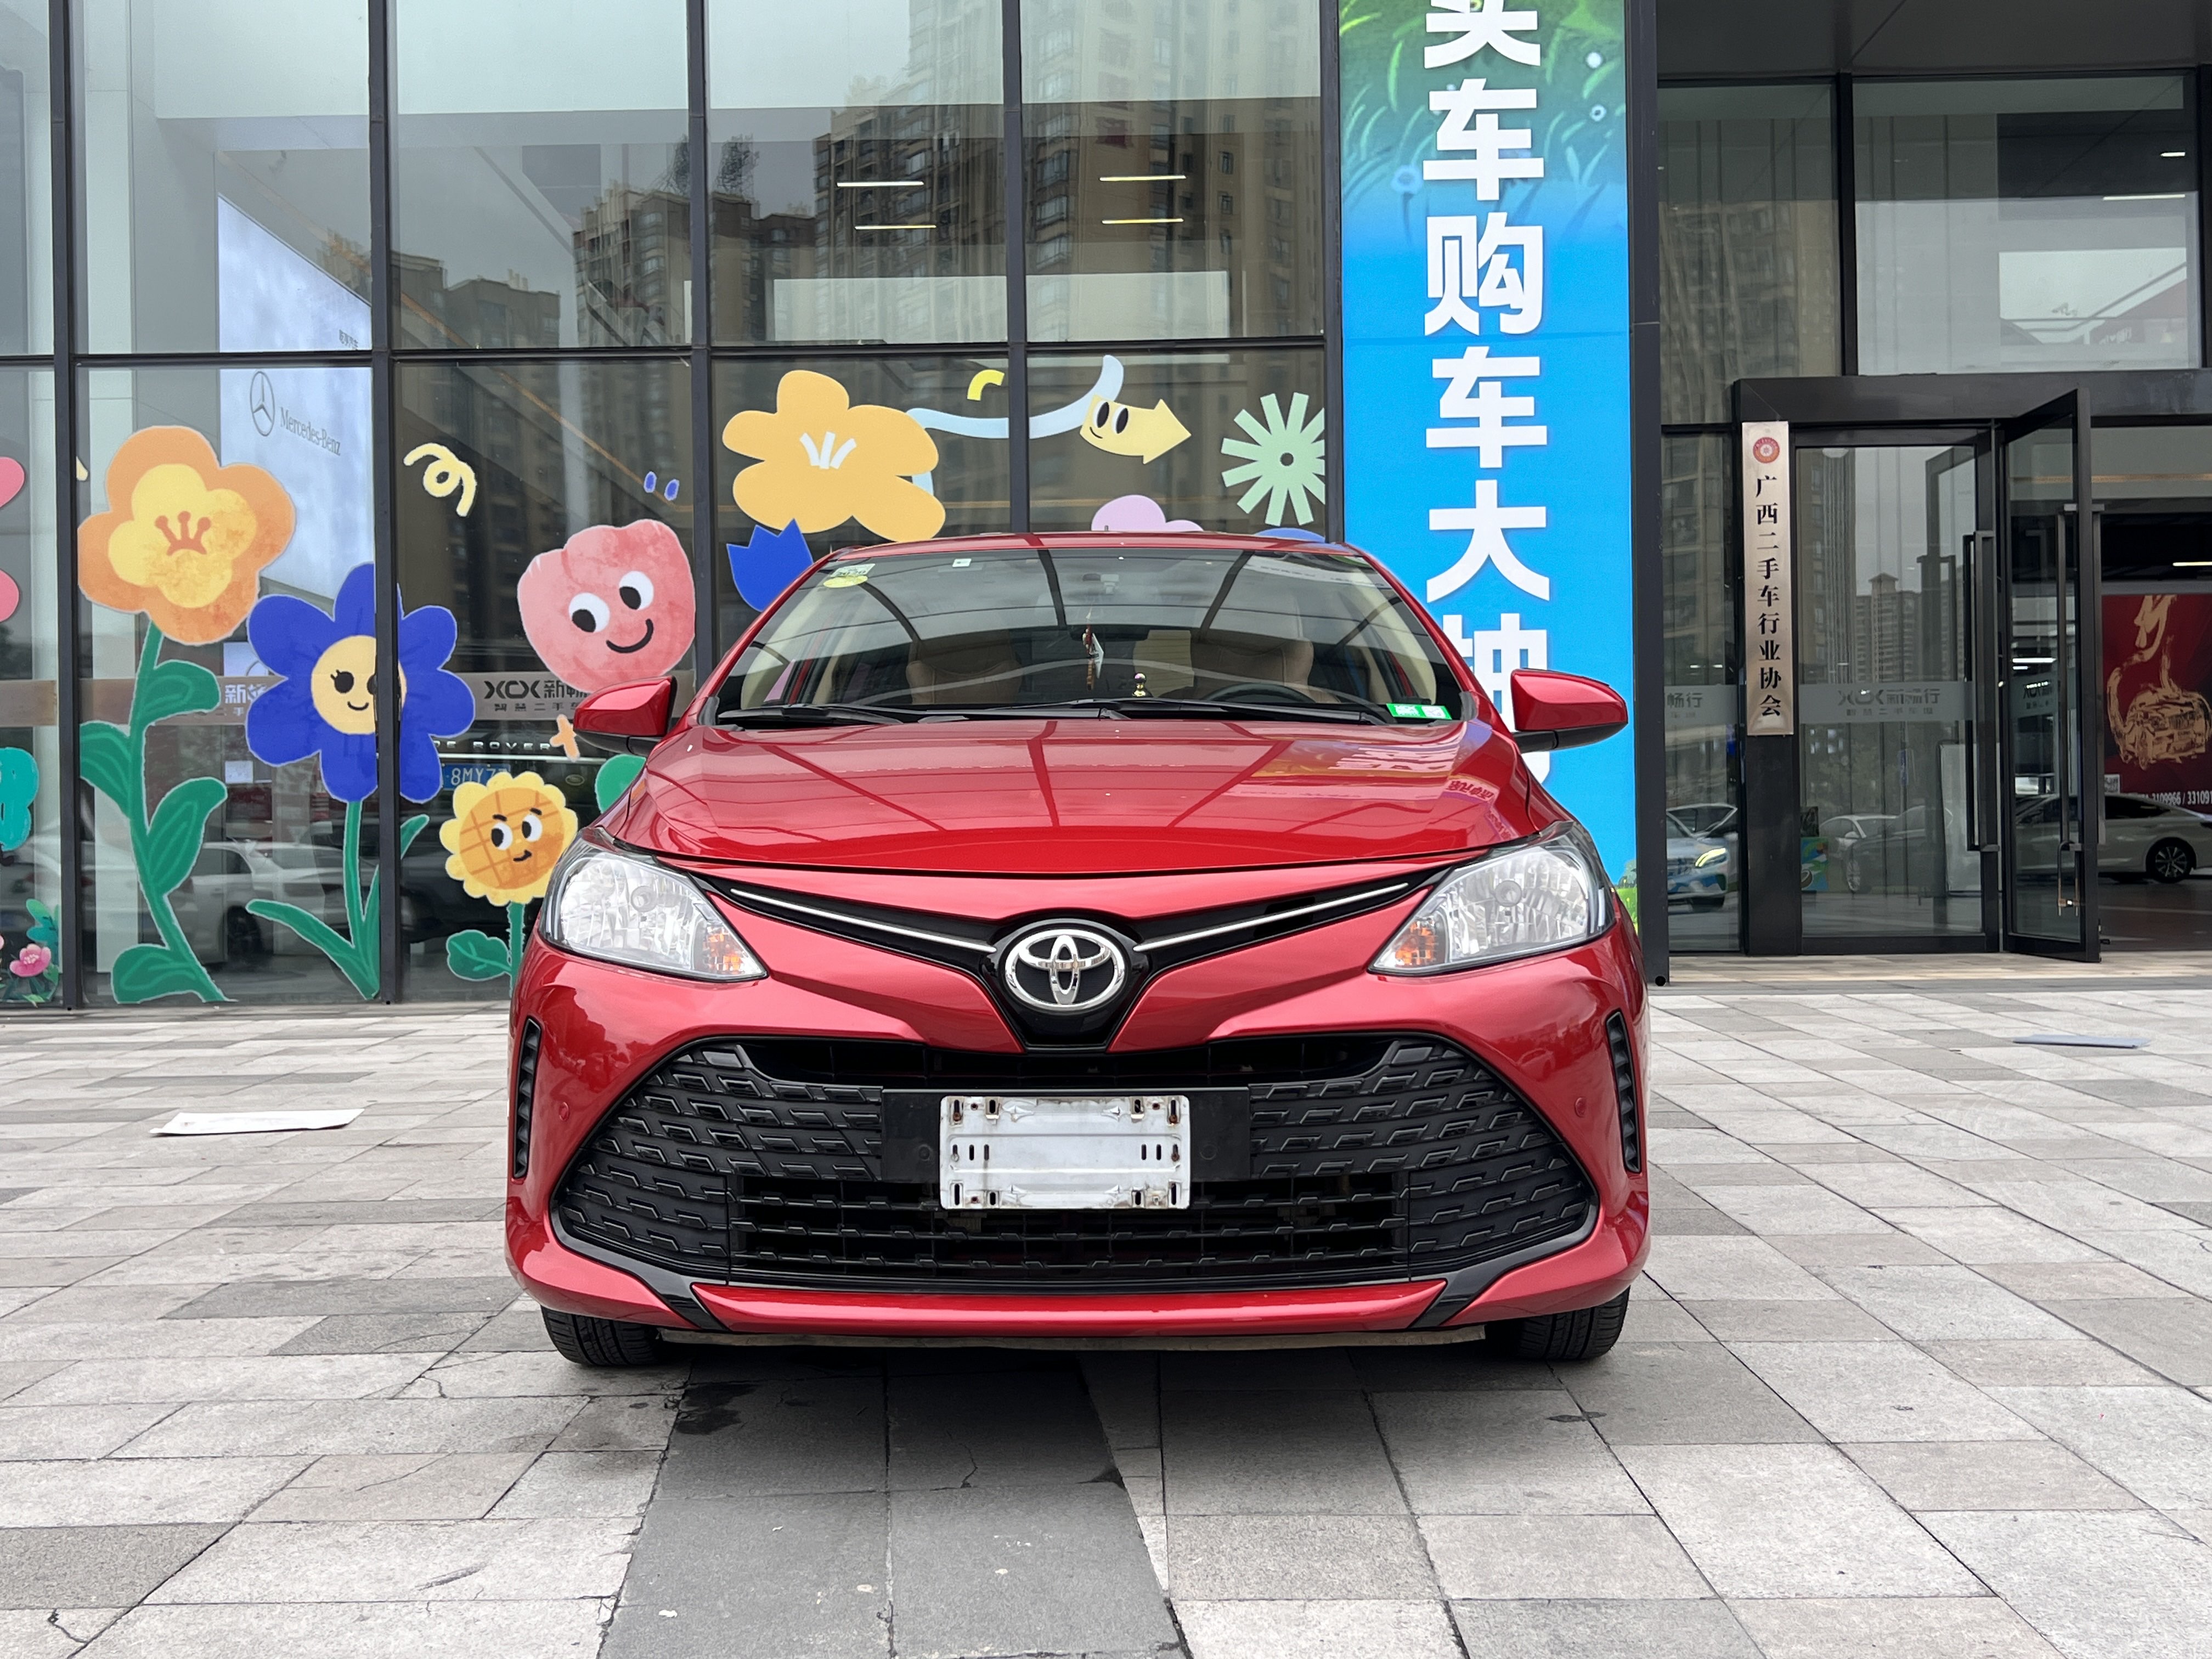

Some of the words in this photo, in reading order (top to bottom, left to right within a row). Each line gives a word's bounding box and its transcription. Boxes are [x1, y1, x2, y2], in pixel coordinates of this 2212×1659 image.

[280, 407, 341, 456] Mercedes-Benz
[1756, 475, 1782, 716] 广西二手车行业协会
[473, 741, 551, 751] ROVER
[451, 768, 507, 786] 8MY7
